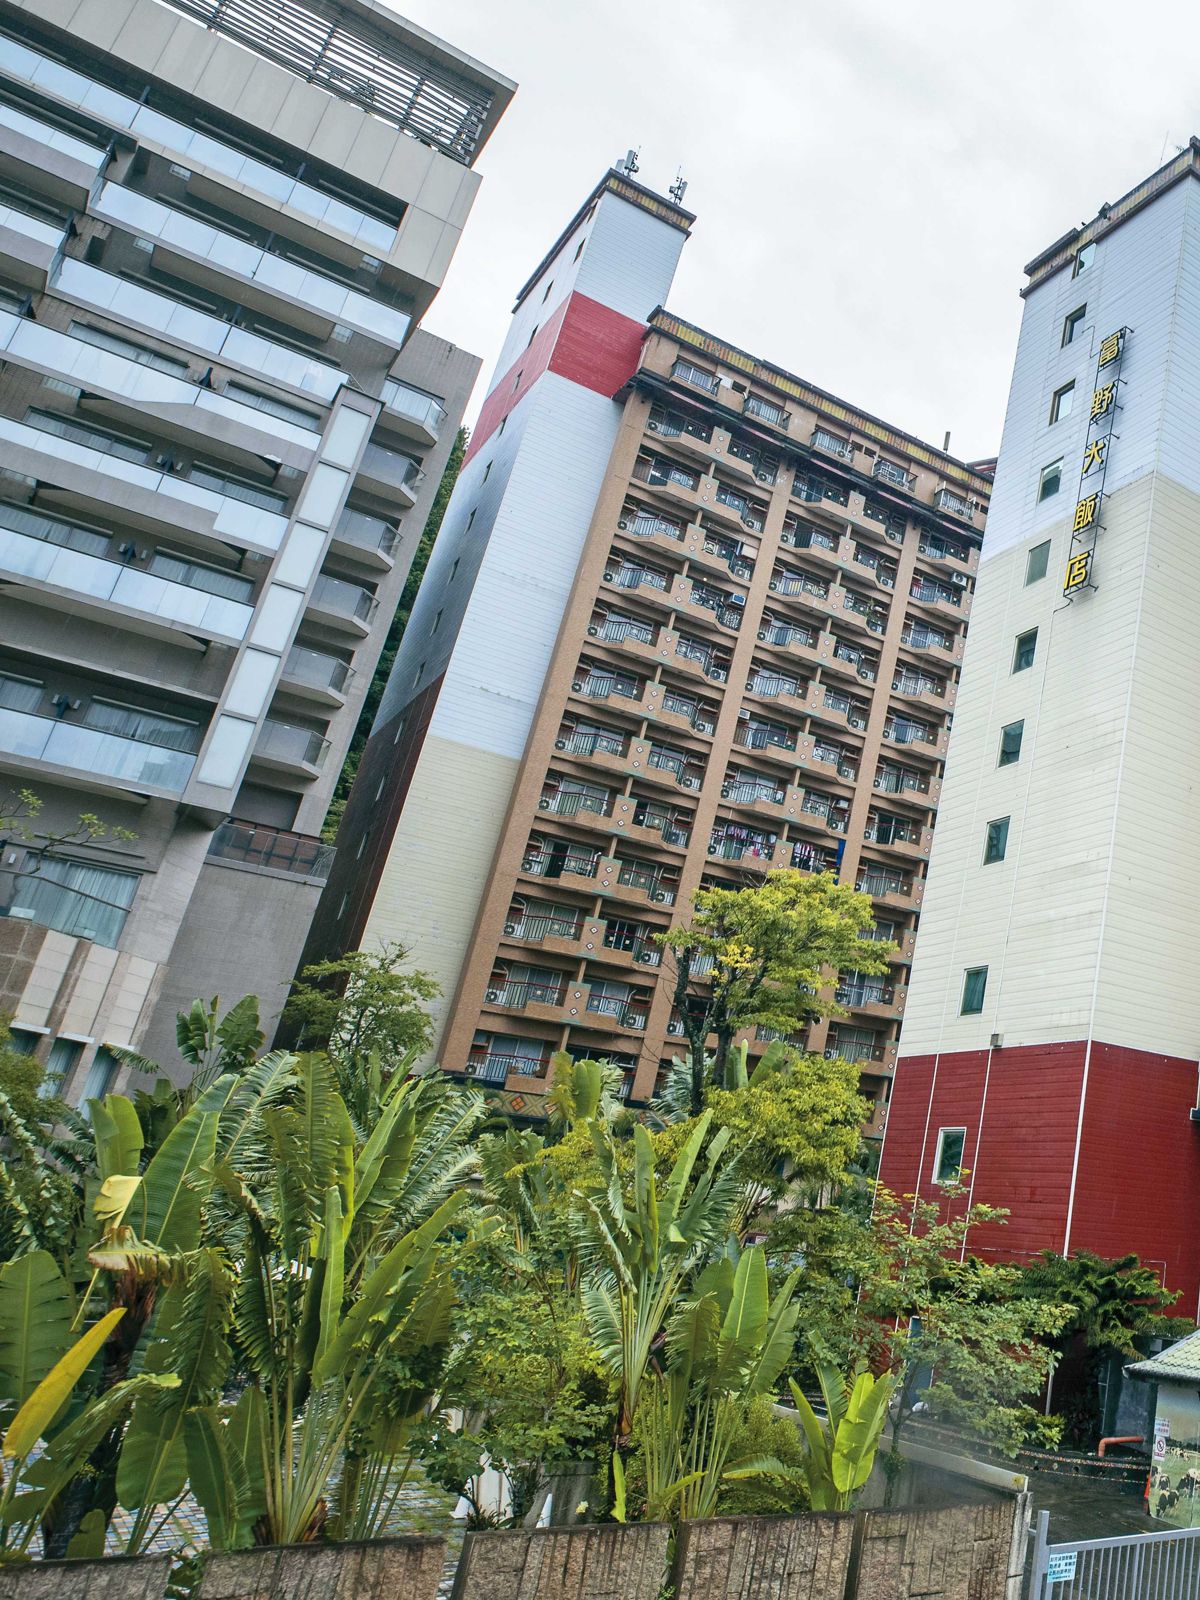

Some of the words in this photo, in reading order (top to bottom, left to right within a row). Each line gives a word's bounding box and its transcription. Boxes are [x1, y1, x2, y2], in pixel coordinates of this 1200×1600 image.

[1063, 332, 1121, 590] 富野大飯店
